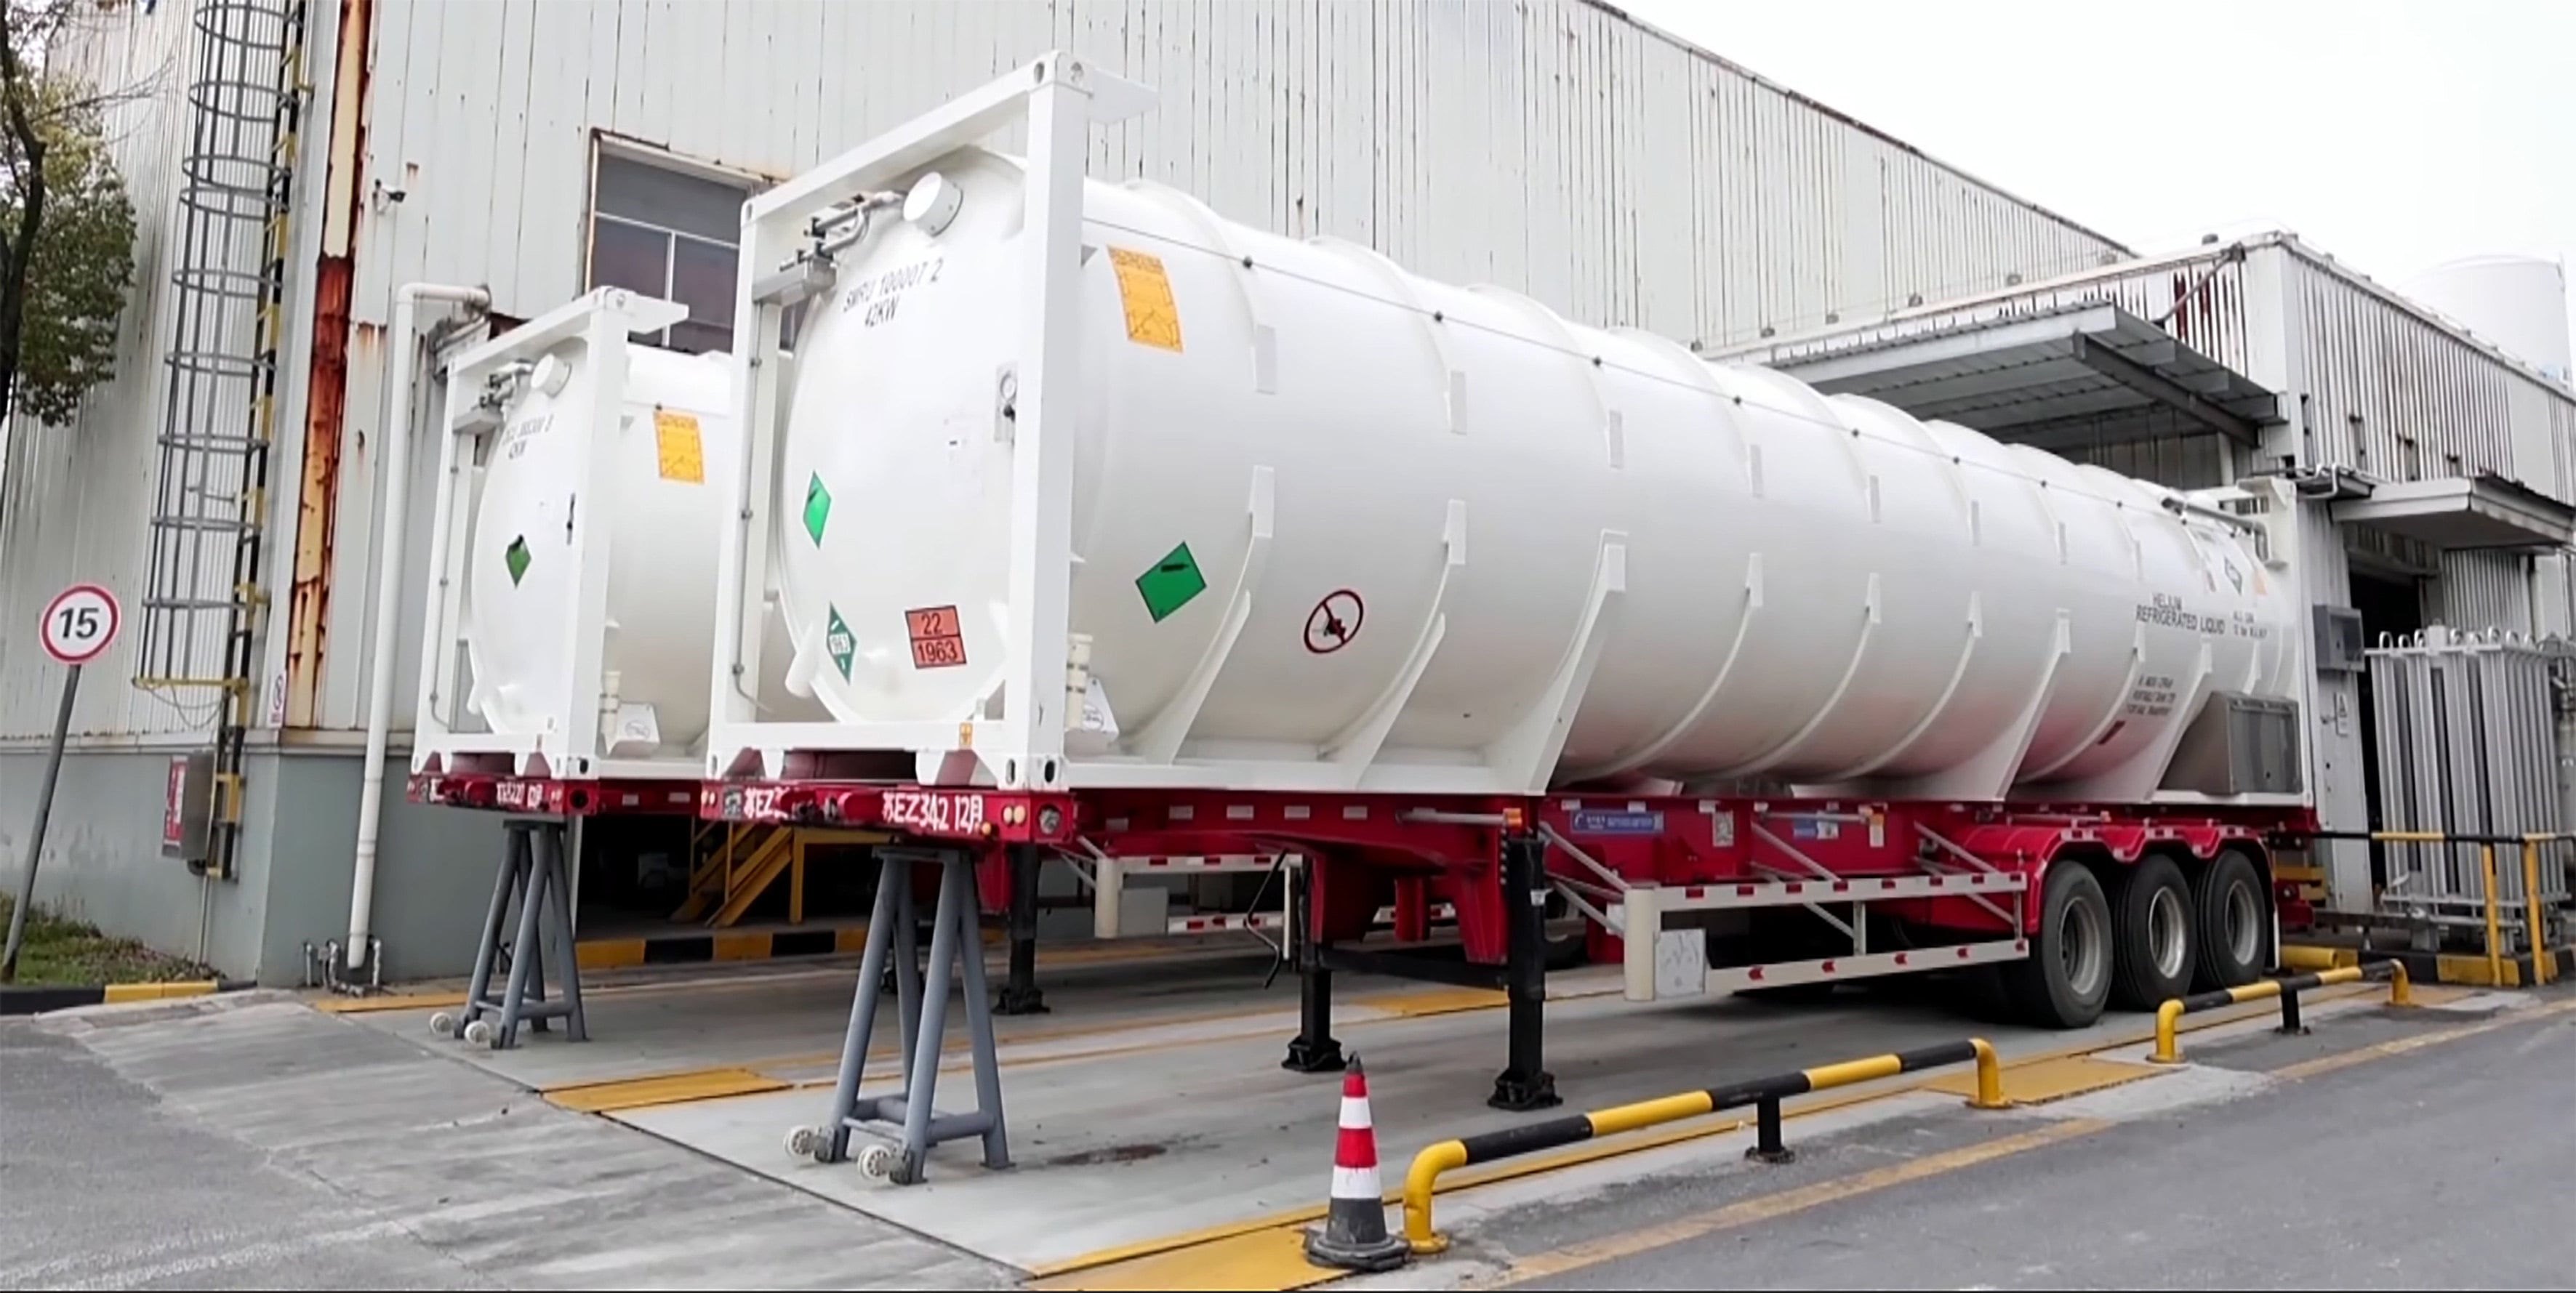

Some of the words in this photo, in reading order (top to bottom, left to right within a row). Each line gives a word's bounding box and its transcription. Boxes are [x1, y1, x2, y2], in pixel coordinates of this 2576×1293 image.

[930, 257, 944, 283] 2
[60, 607, 100, 640] 15
[920, 612, 943, 635] 22
[2135, 604, 2198, 631] REFRIGERATED
[2199, 616, 2226, 635] LIQUID
[918, 640, 958, 663] 1963
